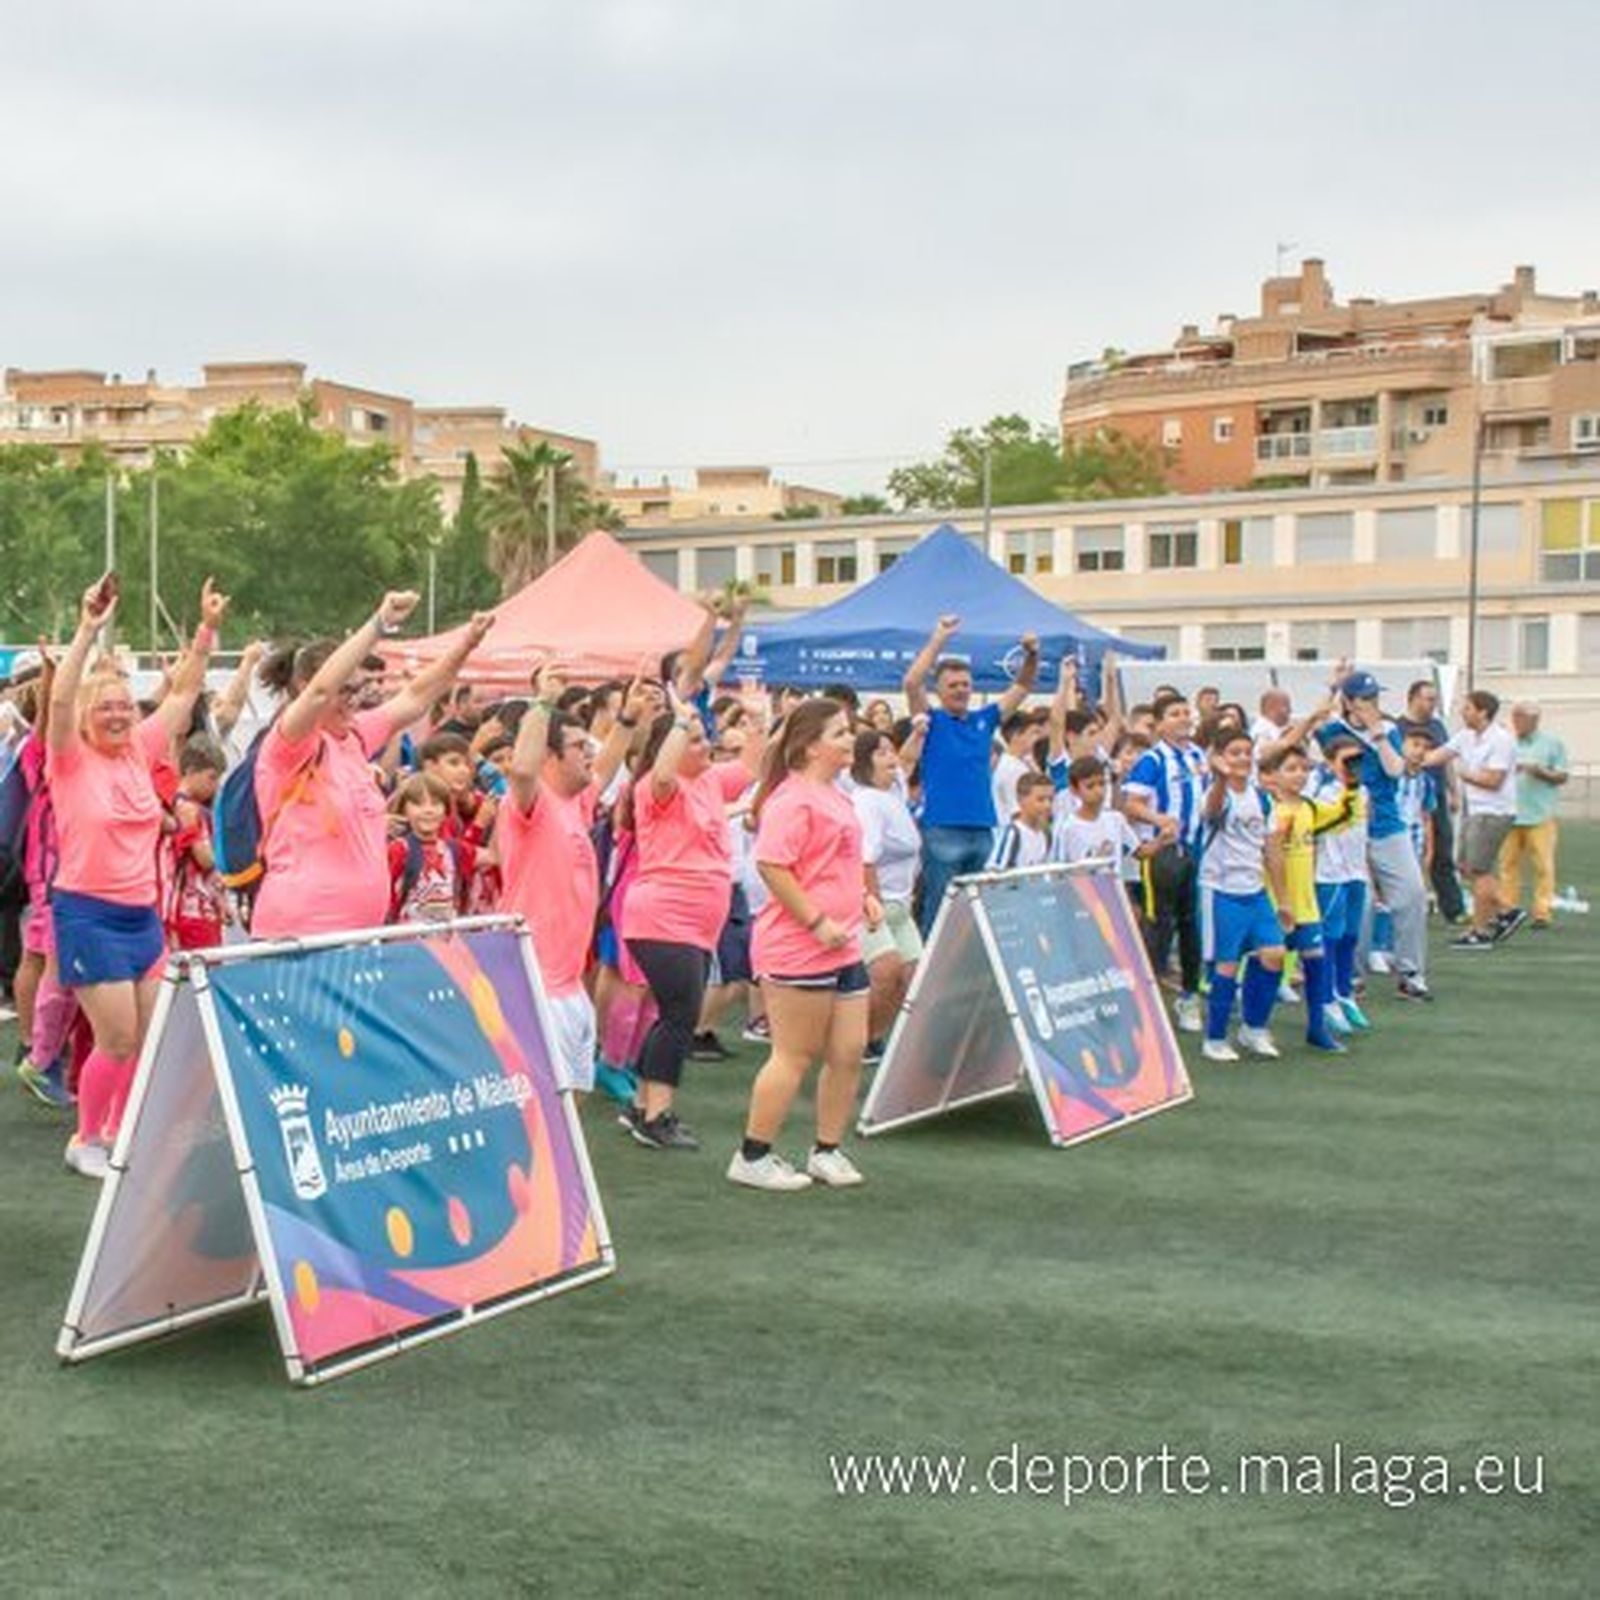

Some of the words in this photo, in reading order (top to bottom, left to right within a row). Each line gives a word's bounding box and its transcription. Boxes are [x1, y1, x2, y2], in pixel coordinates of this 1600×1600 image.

[325, 1090, 451, 1149] Ayuntamiento
[453, 1081, 474, 1116] de
[381, 1141, 433, 1172] Deporte
